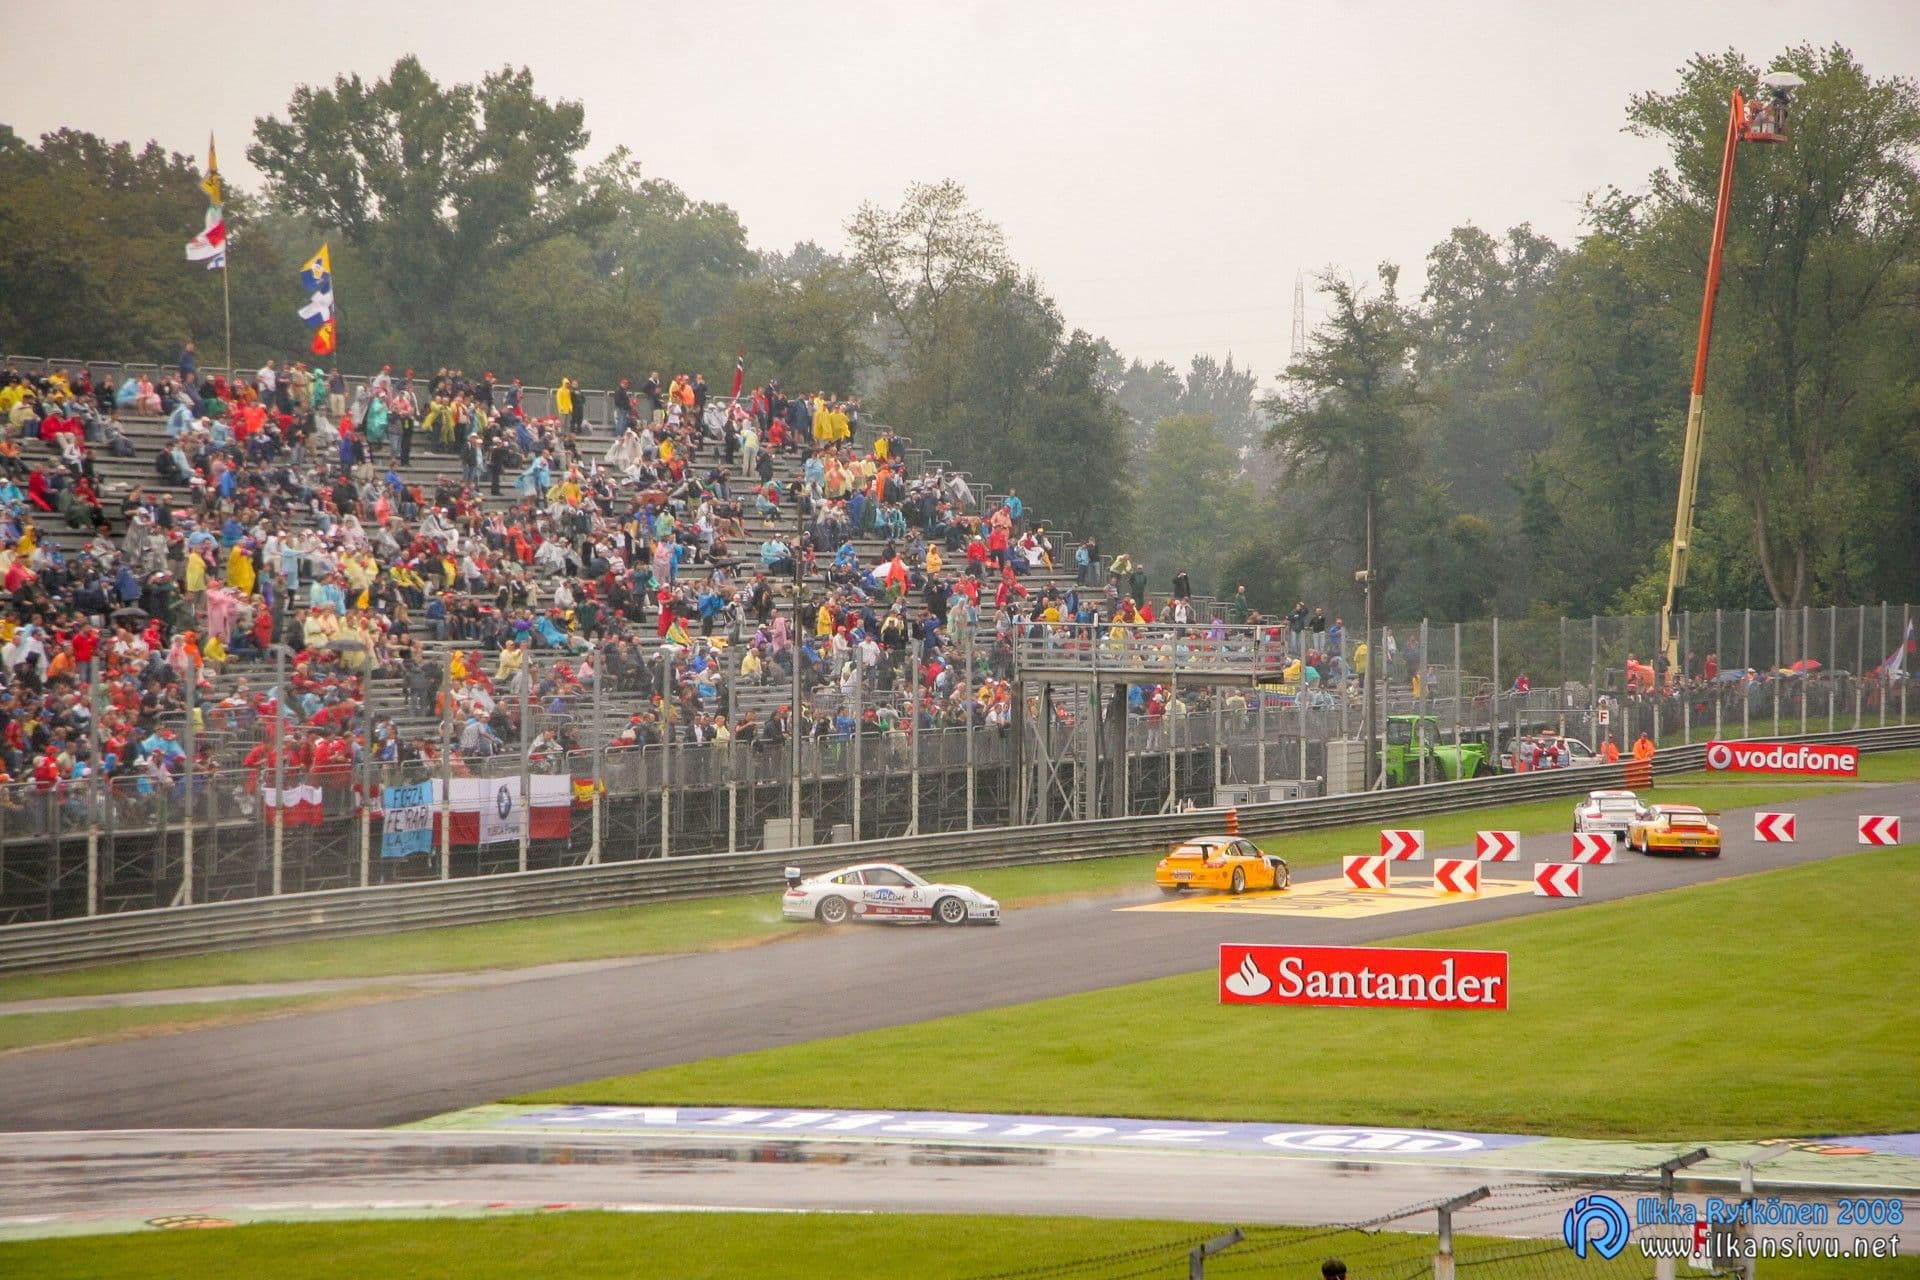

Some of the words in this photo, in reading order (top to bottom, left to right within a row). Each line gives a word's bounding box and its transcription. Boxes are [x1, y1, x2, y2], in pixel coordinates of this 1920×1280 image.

[1600, 712, 1607, 723] F
[1735, 746, 1855, 771] vodafone
[387, 806, 429, 832] FERARI
[912, 889, 919, 899] 8
[1279, 957, 1501, 1003] Santander
[541, 1106, 1230, 1143] Allianz
